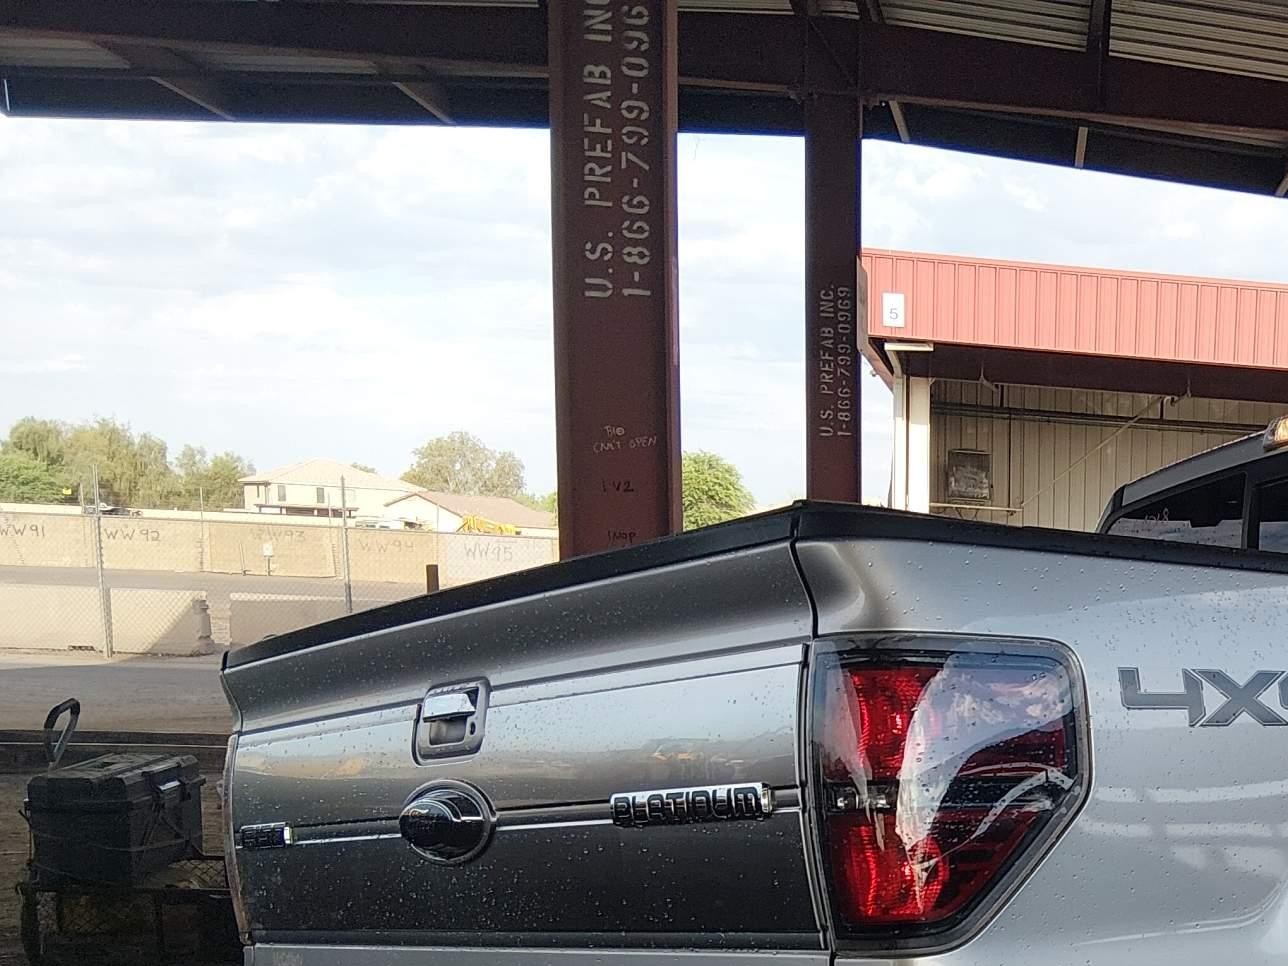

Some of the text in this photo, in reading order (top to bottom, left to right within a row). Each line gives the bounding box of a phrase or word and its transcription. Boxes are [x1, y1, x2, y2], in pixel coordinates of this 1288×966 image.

[583, 0, 614, 299] U.S. PREFAB IN
[819, 284, 834, 437] U.S. PREFAB INC.
[837, 286, 852, 437] 1-866-799-0969
[889, 307, 899, 320] 5
[612, 785, 764, 828] PLATINUM
